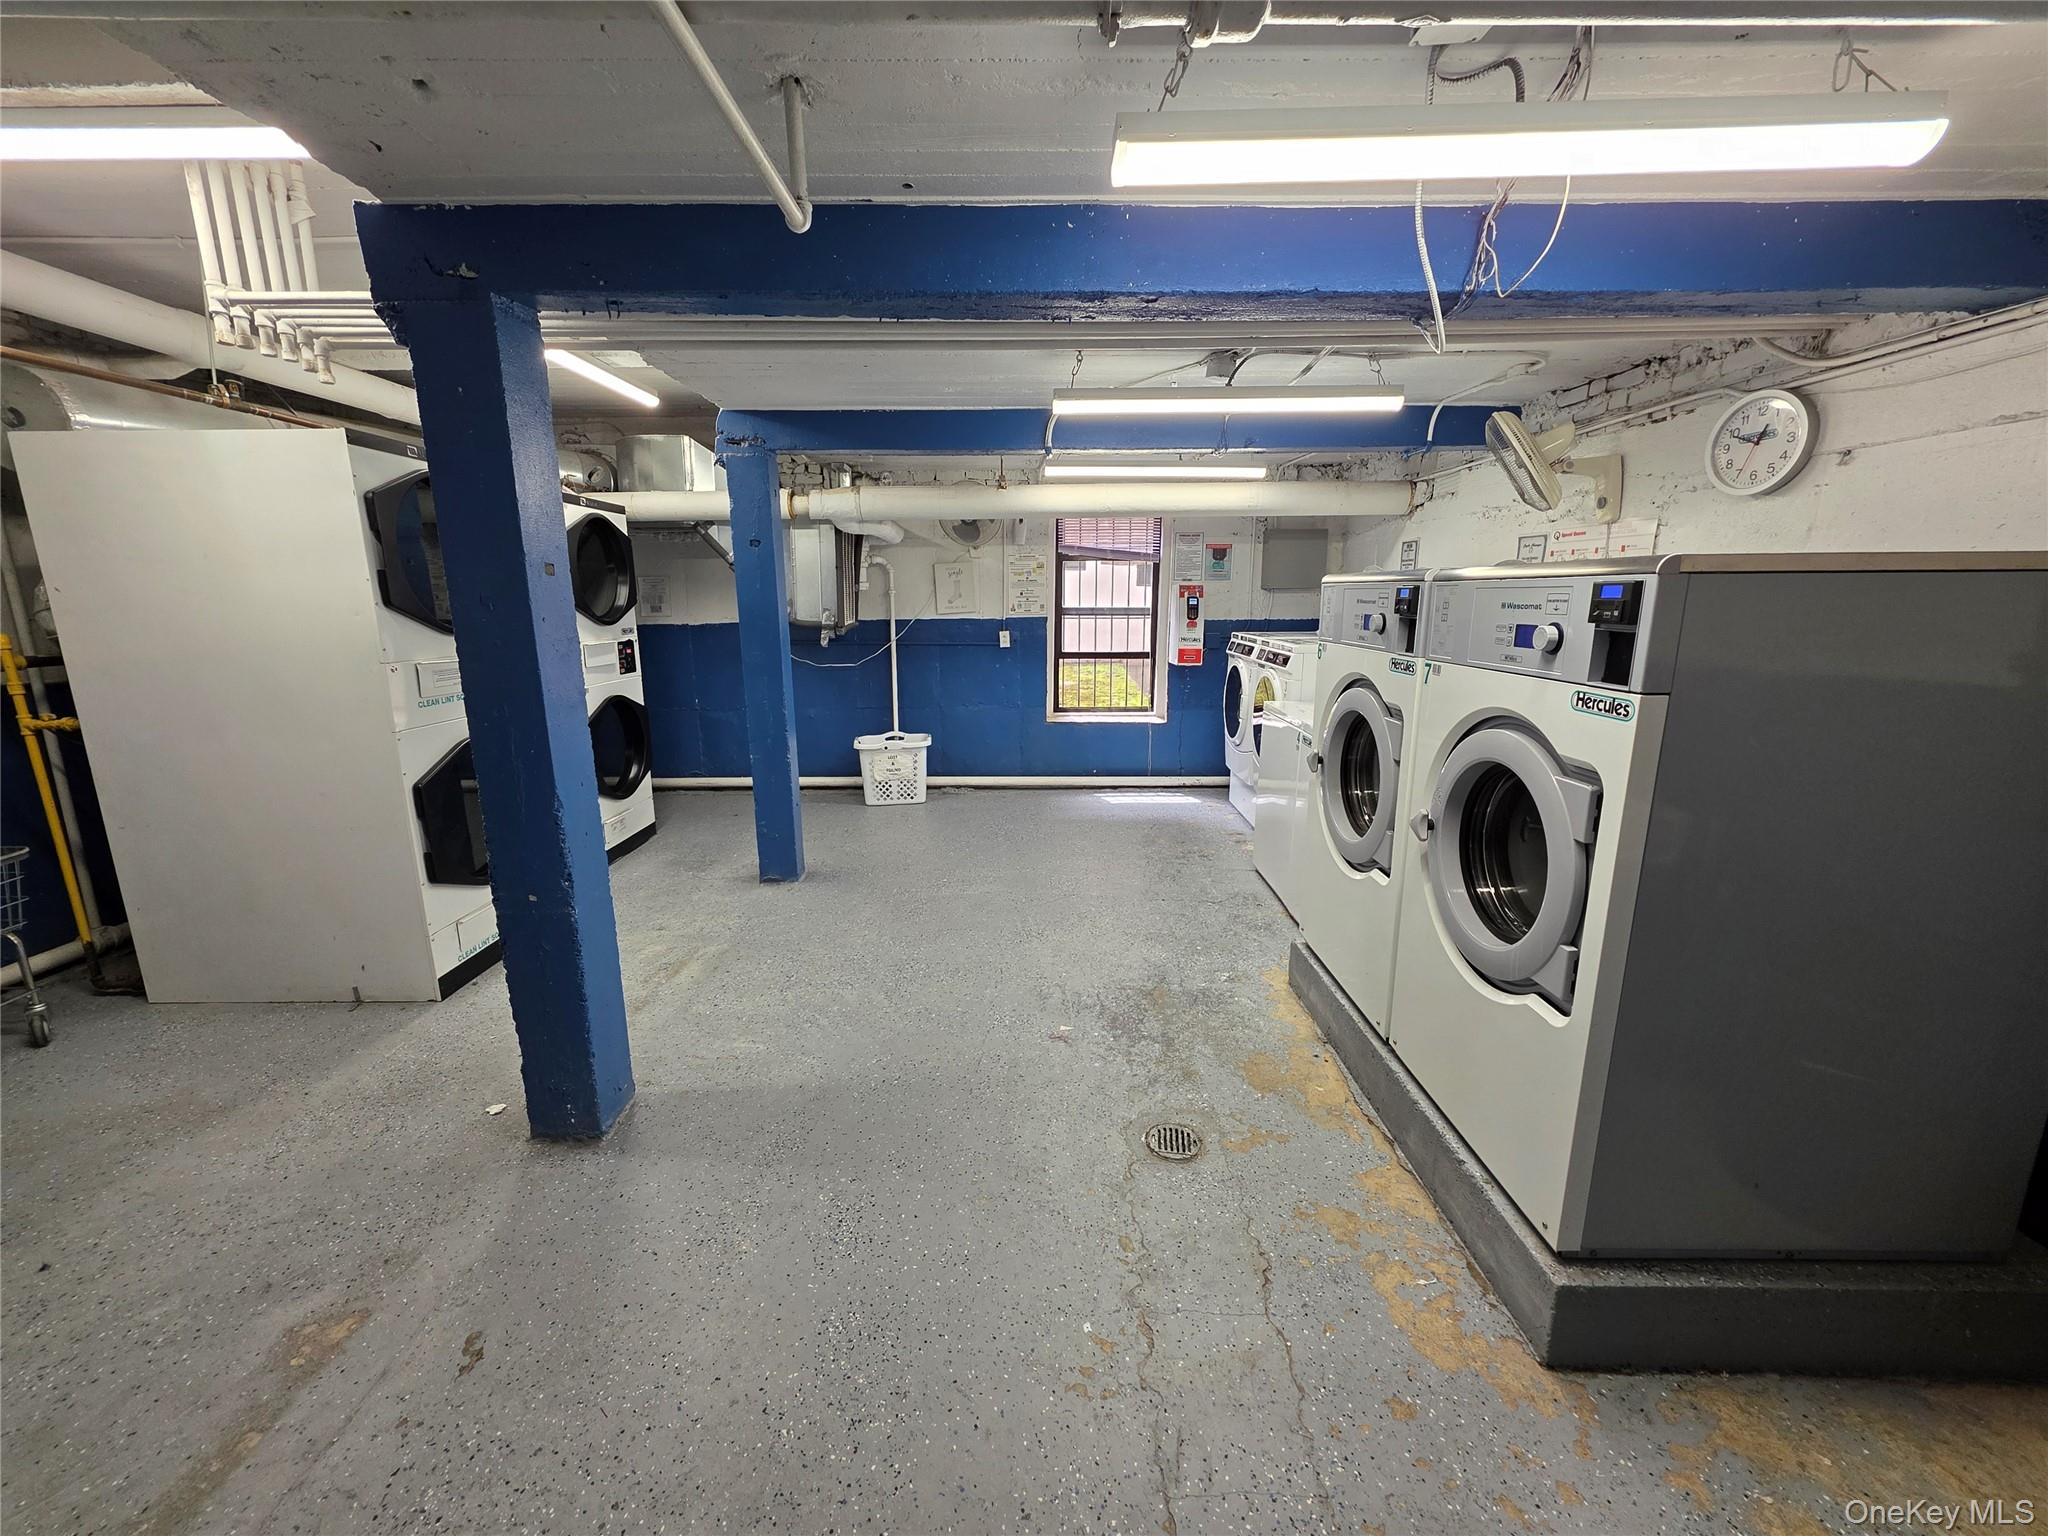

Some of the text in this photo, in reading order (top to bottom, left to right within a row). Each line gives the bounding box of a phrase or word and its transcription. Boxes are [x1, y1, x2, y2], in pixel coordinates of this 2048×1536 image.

[1758, 406, 1768, 417] 12
[1742, 415, 1750, 425] 11
[1786, 417, 1795, 428] 2
[1728, 428, 1740, 439] 10
[1787, 432, 1796, 443] 3
[1722, 444, 1730, 454] 9
[1780, 450, 1788, 460] 4
[1726, 459, 1734, 470] 8
[1767, 463, 1775, 473] 5
[1736, 469, 1743, 479] 7
[1750, 471, 1758, 480] 6
[1507, 602, 1542, 610] Wascomat
[1318, 643, 1322, 659] 6
[1391, 658, 1415, 673] Hercules
[1425, 663, 1431, 684] 7
[418, 698, 440, 708] CLEAN
[441, 695, 454, 704] LINT
[1576, 691, 1630, 717] Hercules
[458, 945, 478, 962] CLEAN
[478, 937, 490, 950] LINT
